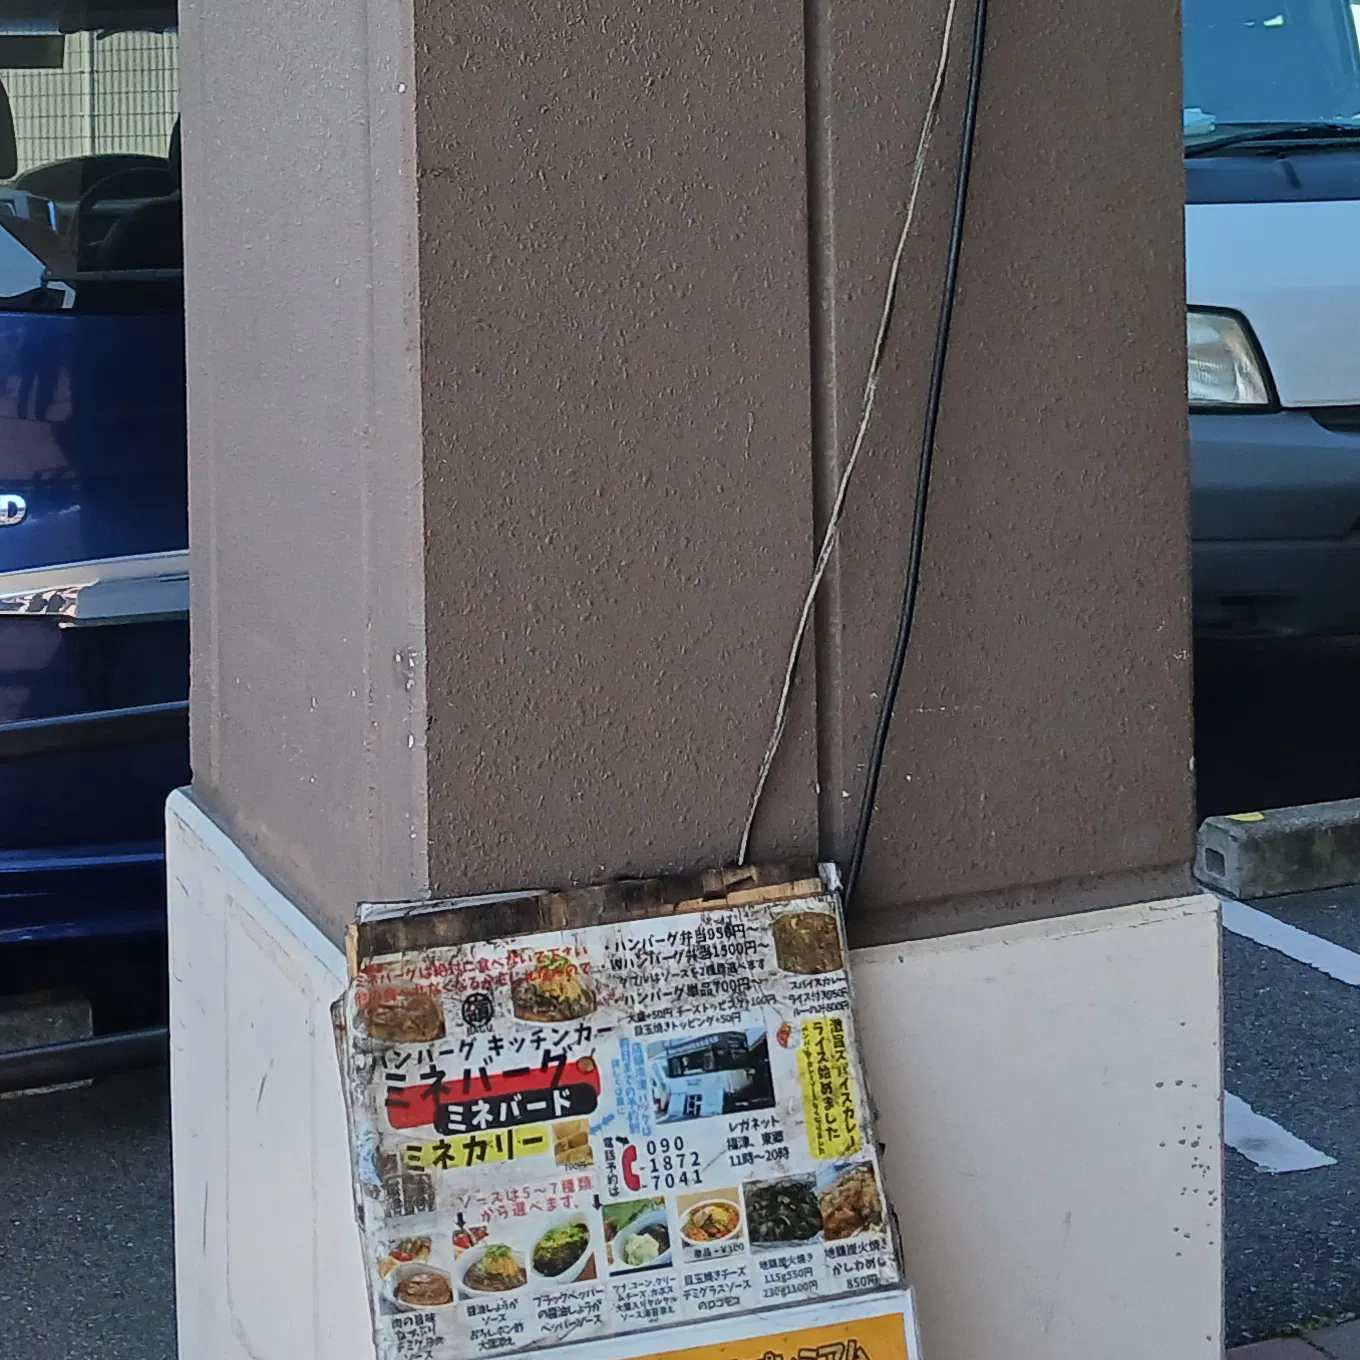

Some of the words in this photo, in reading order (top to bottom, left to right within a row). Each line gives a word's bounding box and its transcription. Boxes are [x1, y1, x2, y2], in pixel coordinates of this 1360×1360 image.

[385, 1044, 574, 1108] ミネバーグ
[447, 1088, 571, 1132] ミネバード
[406, 1129, 544, 1172] ミネカリー
[646, 1135, 685, 1156] 090
[482, 1312, 508, 1327] ソース
